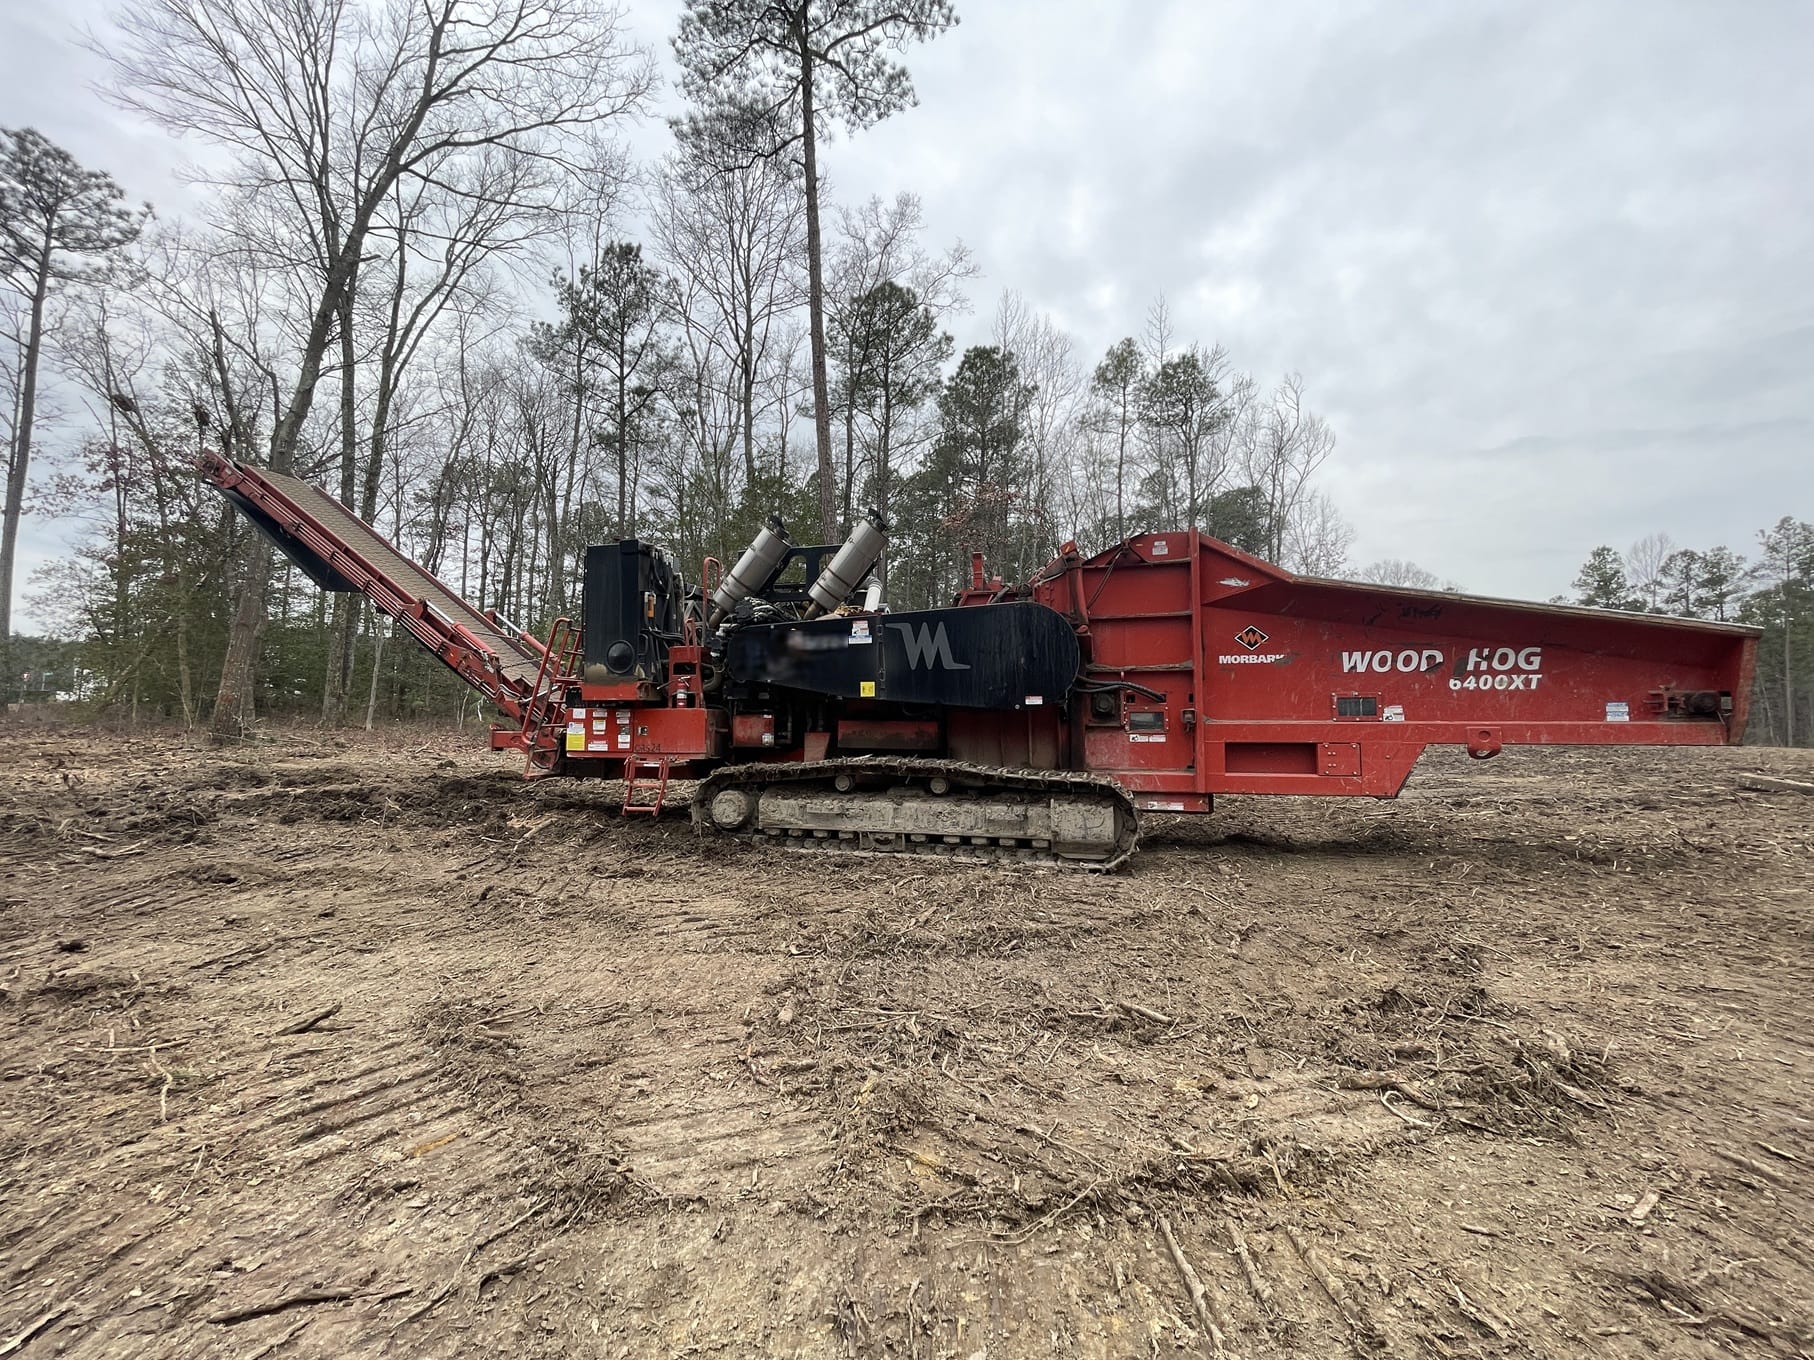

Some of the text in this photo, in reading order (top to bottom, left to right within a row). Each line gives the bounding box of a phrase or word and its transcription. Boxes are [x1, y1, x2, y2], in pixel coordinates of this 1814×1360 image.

[1341, 647, 1542, 673] WOOD HOG
[1449, 674, 1543, 690] 6400XT
